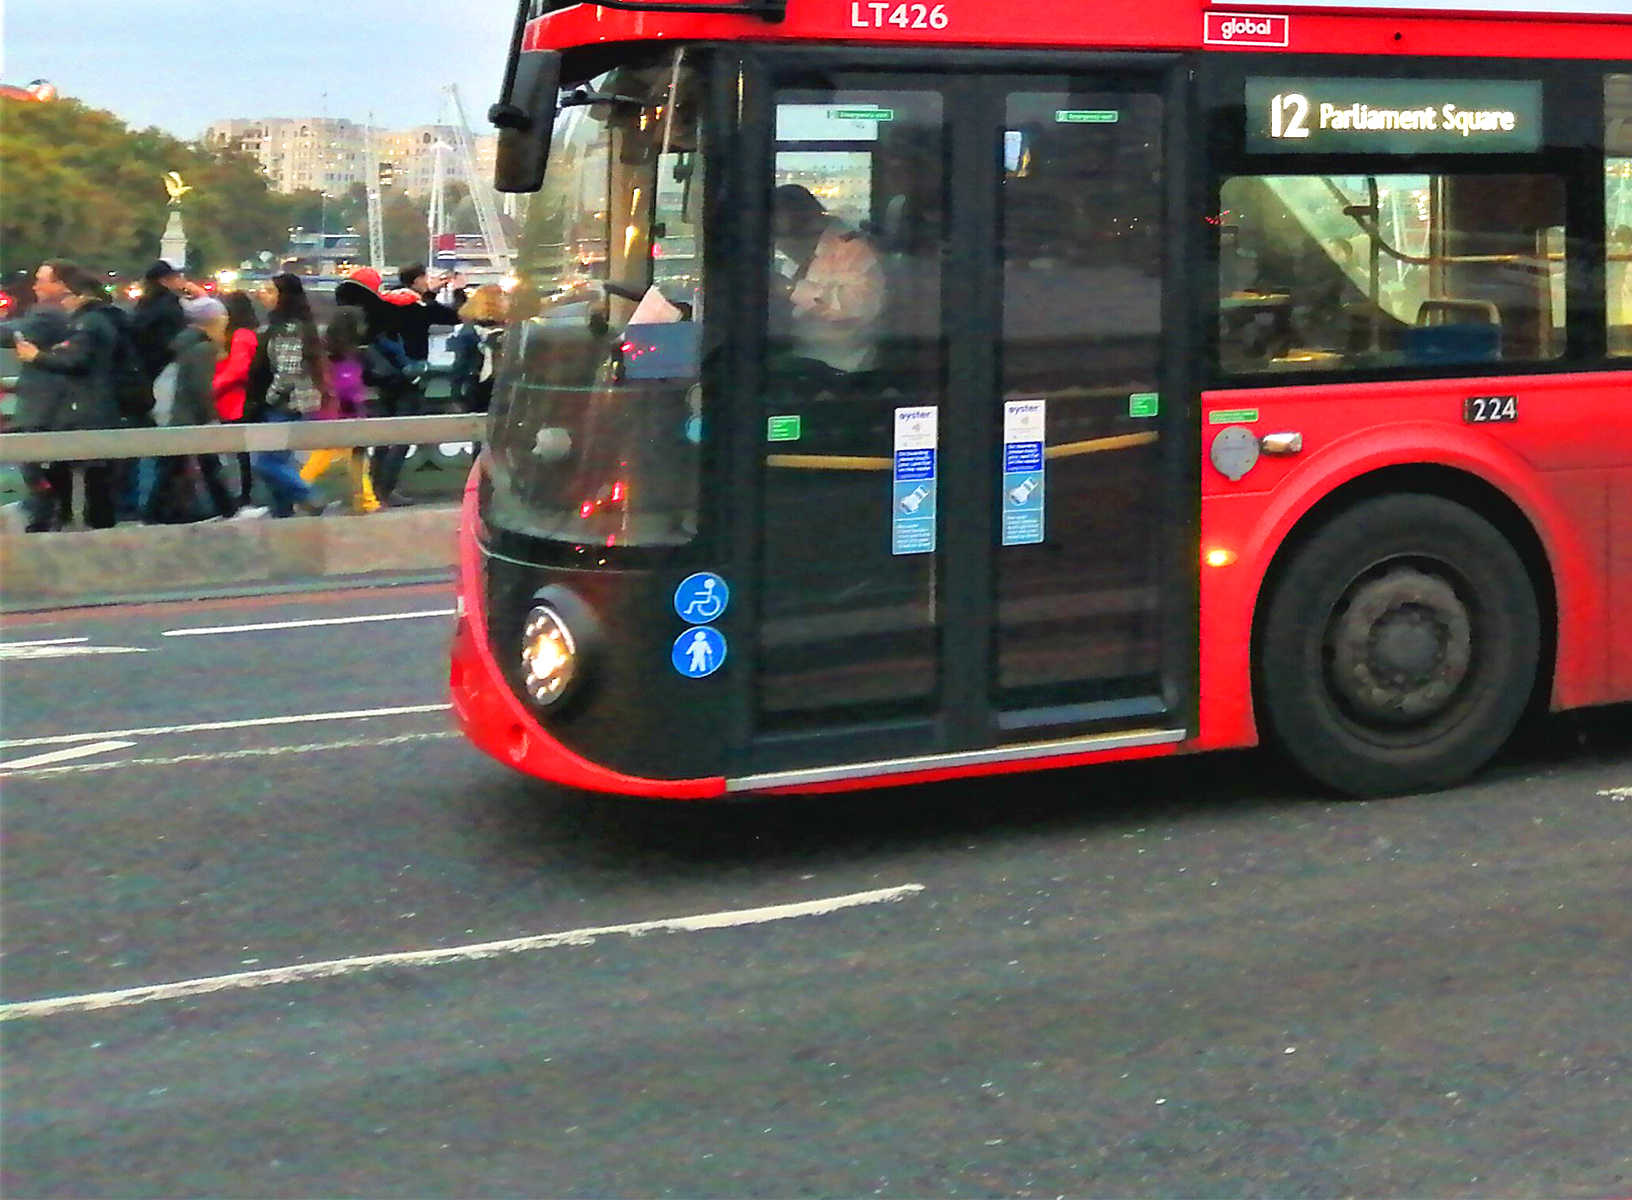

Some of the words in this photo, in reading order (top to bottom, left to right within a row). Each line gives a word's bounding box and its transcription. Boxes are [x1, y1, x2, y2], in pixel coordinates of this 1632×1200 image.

[851, 1, 949, 30] LT426
[1221, 17, 1271, 40] global
[1270, 92, 1311, 138] 12
[1319, 102, 1438, 131] Parliament
[1441, 103, 1516, 137] Square
[1472, 397, 1516, 422] 224
